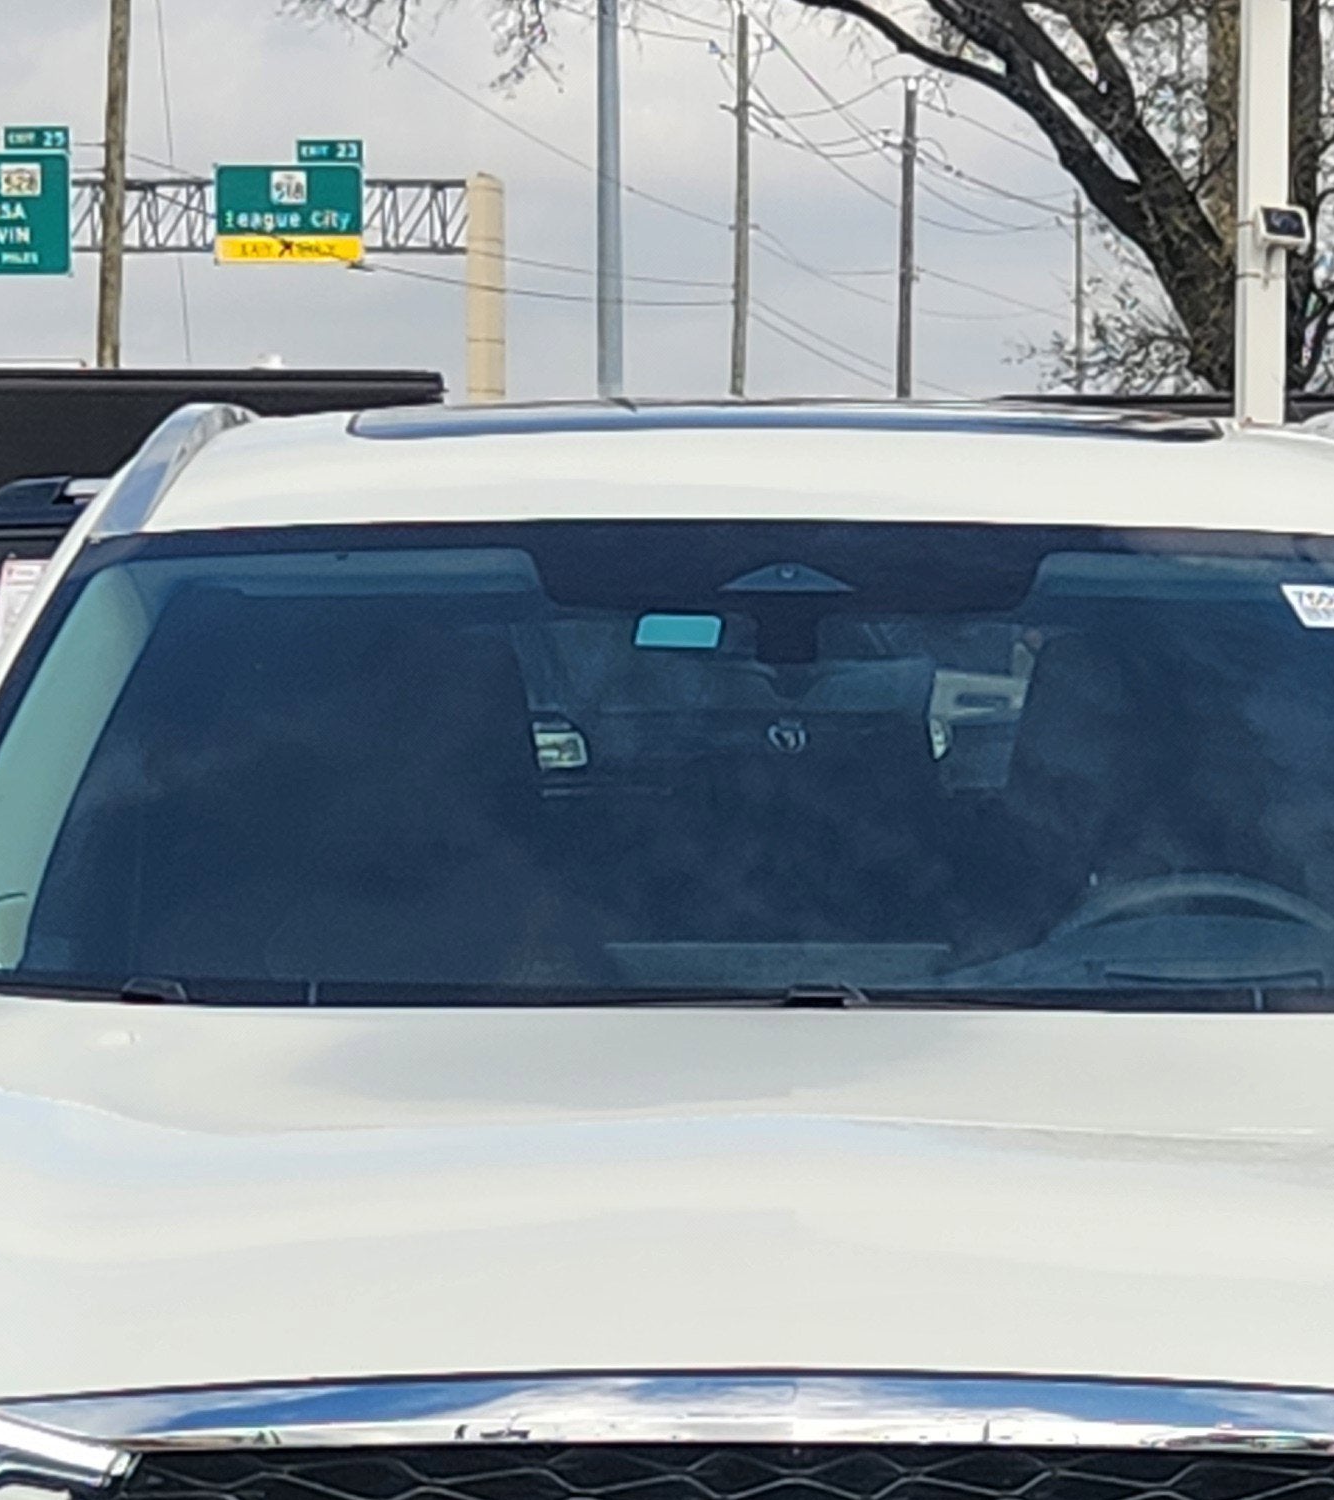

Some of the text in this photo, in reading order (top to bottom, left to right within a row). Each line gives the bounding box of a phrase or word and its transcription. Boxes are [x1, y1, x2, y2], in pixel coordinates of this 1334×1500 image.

[7, 132, 35, 145] EXIT
[300, 143, 358, 158] EXIT 23
[310, 208, 352, 231] City
